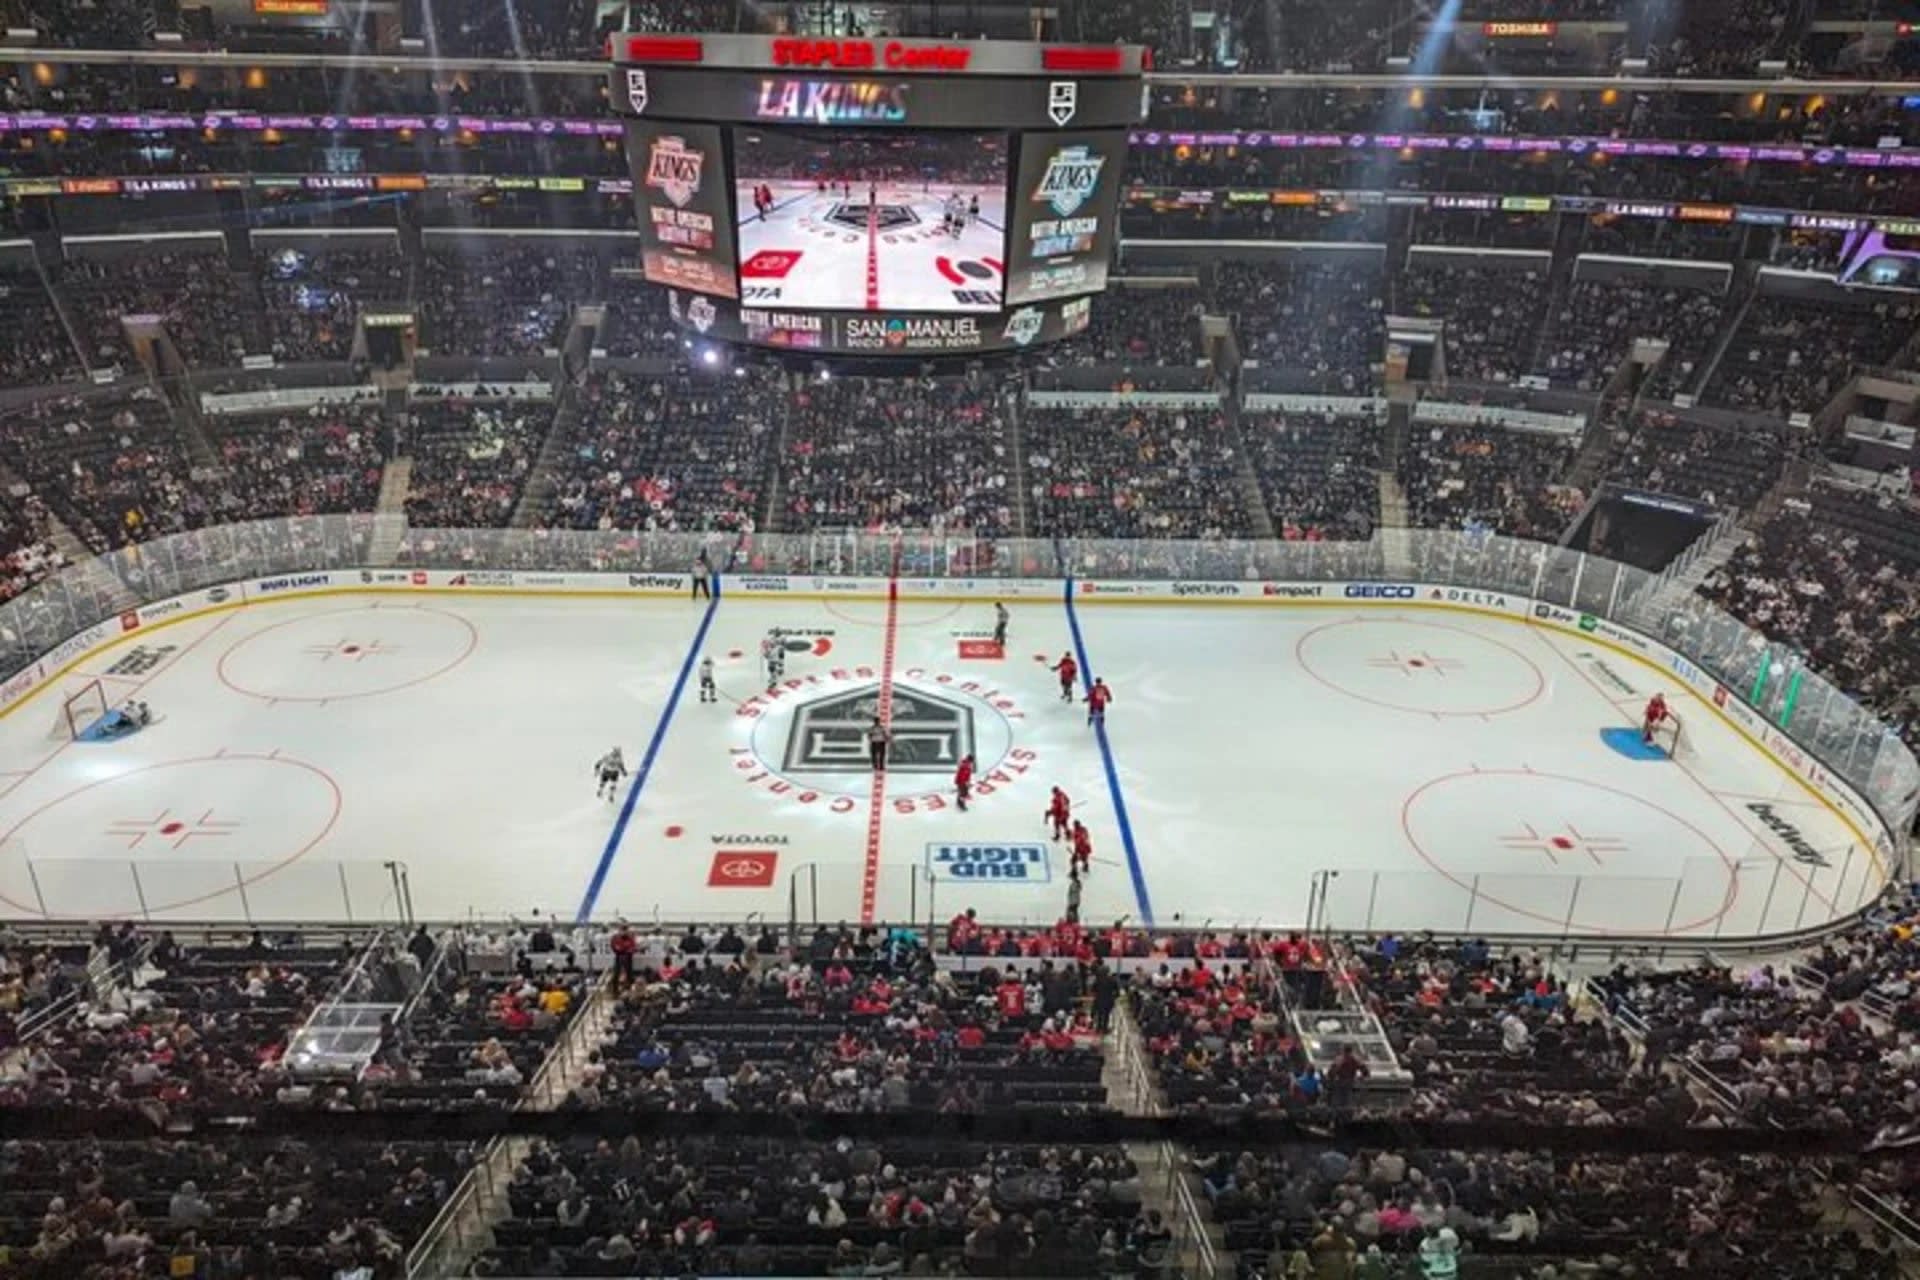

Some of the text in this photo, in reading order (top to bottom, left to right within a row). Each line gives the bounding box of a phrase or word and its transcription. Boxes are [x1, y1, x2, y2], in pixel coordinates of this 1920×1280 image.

[772, 38, 971, 69] STAPLES Center
[757, 80, 910, 123] LA KINGS
[652, 153, 697, 182] KINGS
[1043, 164, 1097, 191] KINGS
[847, 318, 981, 337] SAN MANUEL
[259, 575, 330, 591] BUD LIGHT
[629, 575, 683, 590] betway
[1172, 582, 1240, 596] Spectrum
[1345, 585, 1415, 598] GEICO
[1448, 590, 1506, 607] DELTA
[736, 667, 1026, 719] STAPLES Center
[893, 748, 1037, 815] STAPES
[711, 834, 790, 845] TOYOTA
[1747, 802, 1833, 868] betway
[934, 847, 1041, 863] LIGHT
[949, 862, 1028, 877] BUD
